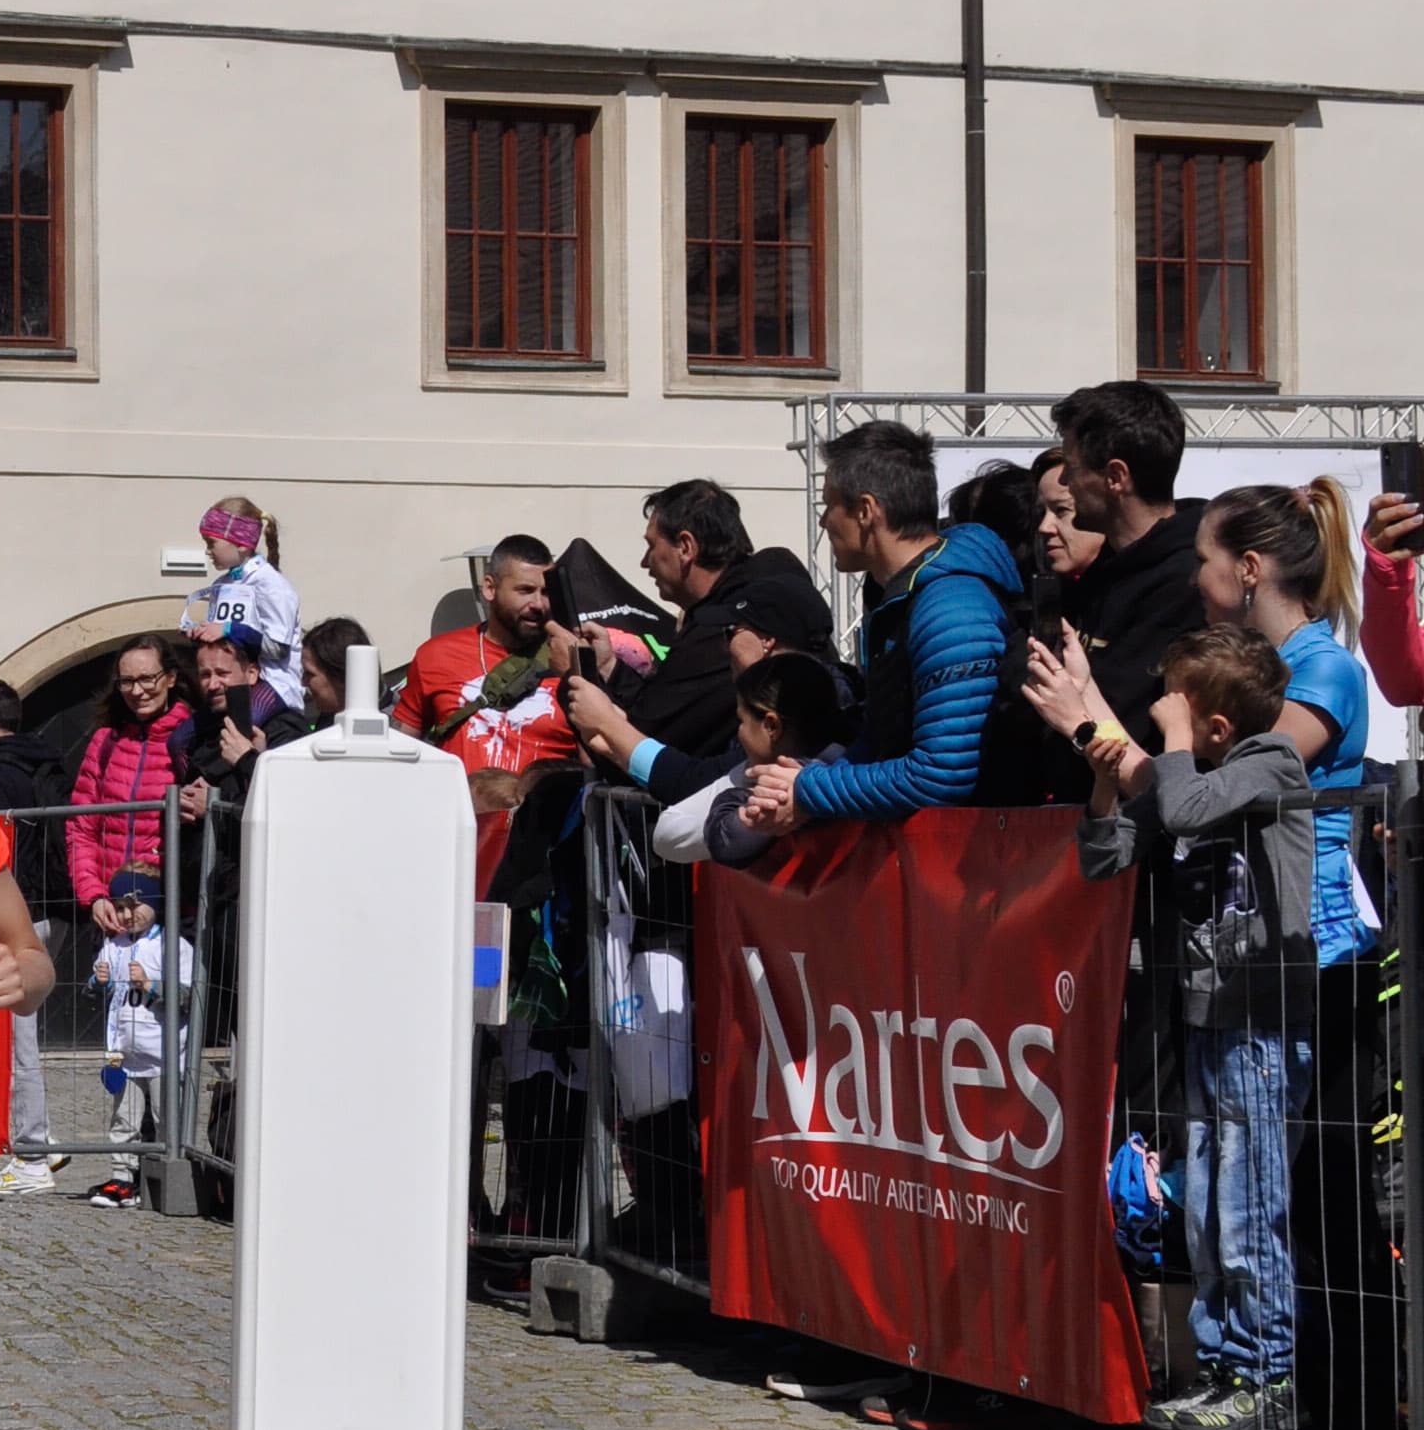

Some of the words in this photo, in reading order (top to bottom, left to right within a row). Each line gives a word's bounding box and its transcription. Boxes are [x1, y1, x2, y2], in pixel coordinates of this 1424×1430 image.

[741, 947, 1064, 1169] Nartes
[771, 1157, 798, 1189] TOP
[802, 1164, 880, 1204] QUALITY
[965, 1193, 1029, 1234] SPRING
